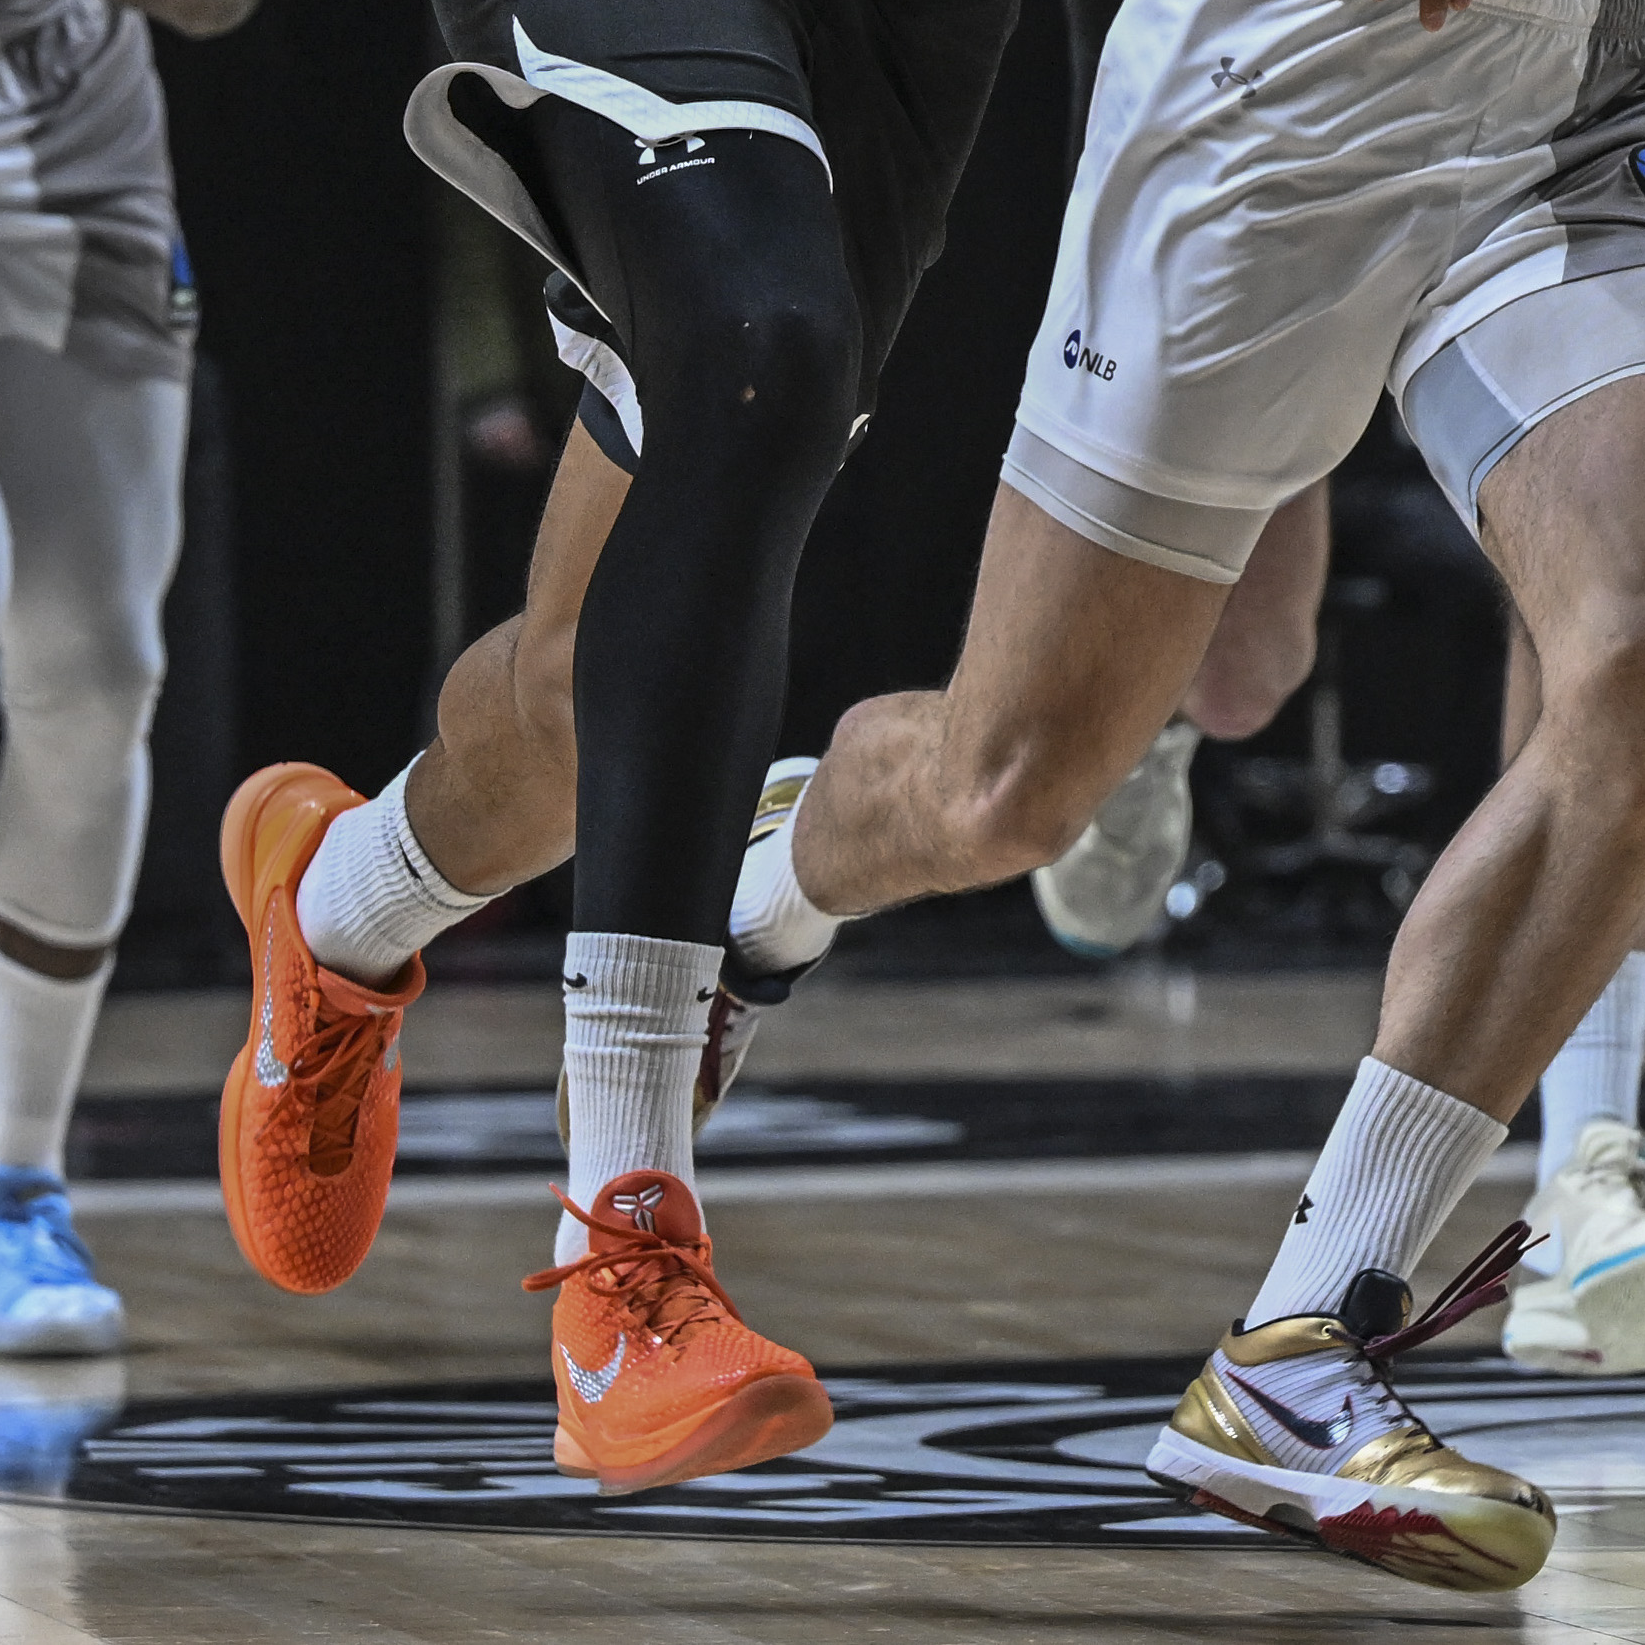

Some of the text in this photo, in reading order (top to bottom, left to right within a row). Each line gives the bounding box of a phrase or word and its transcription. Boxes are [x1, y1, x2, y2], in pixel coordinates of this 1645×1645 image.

[636, 157, 716, 185] UNDER ARMOUR
[1079, 347, 1117, 382] NLB
